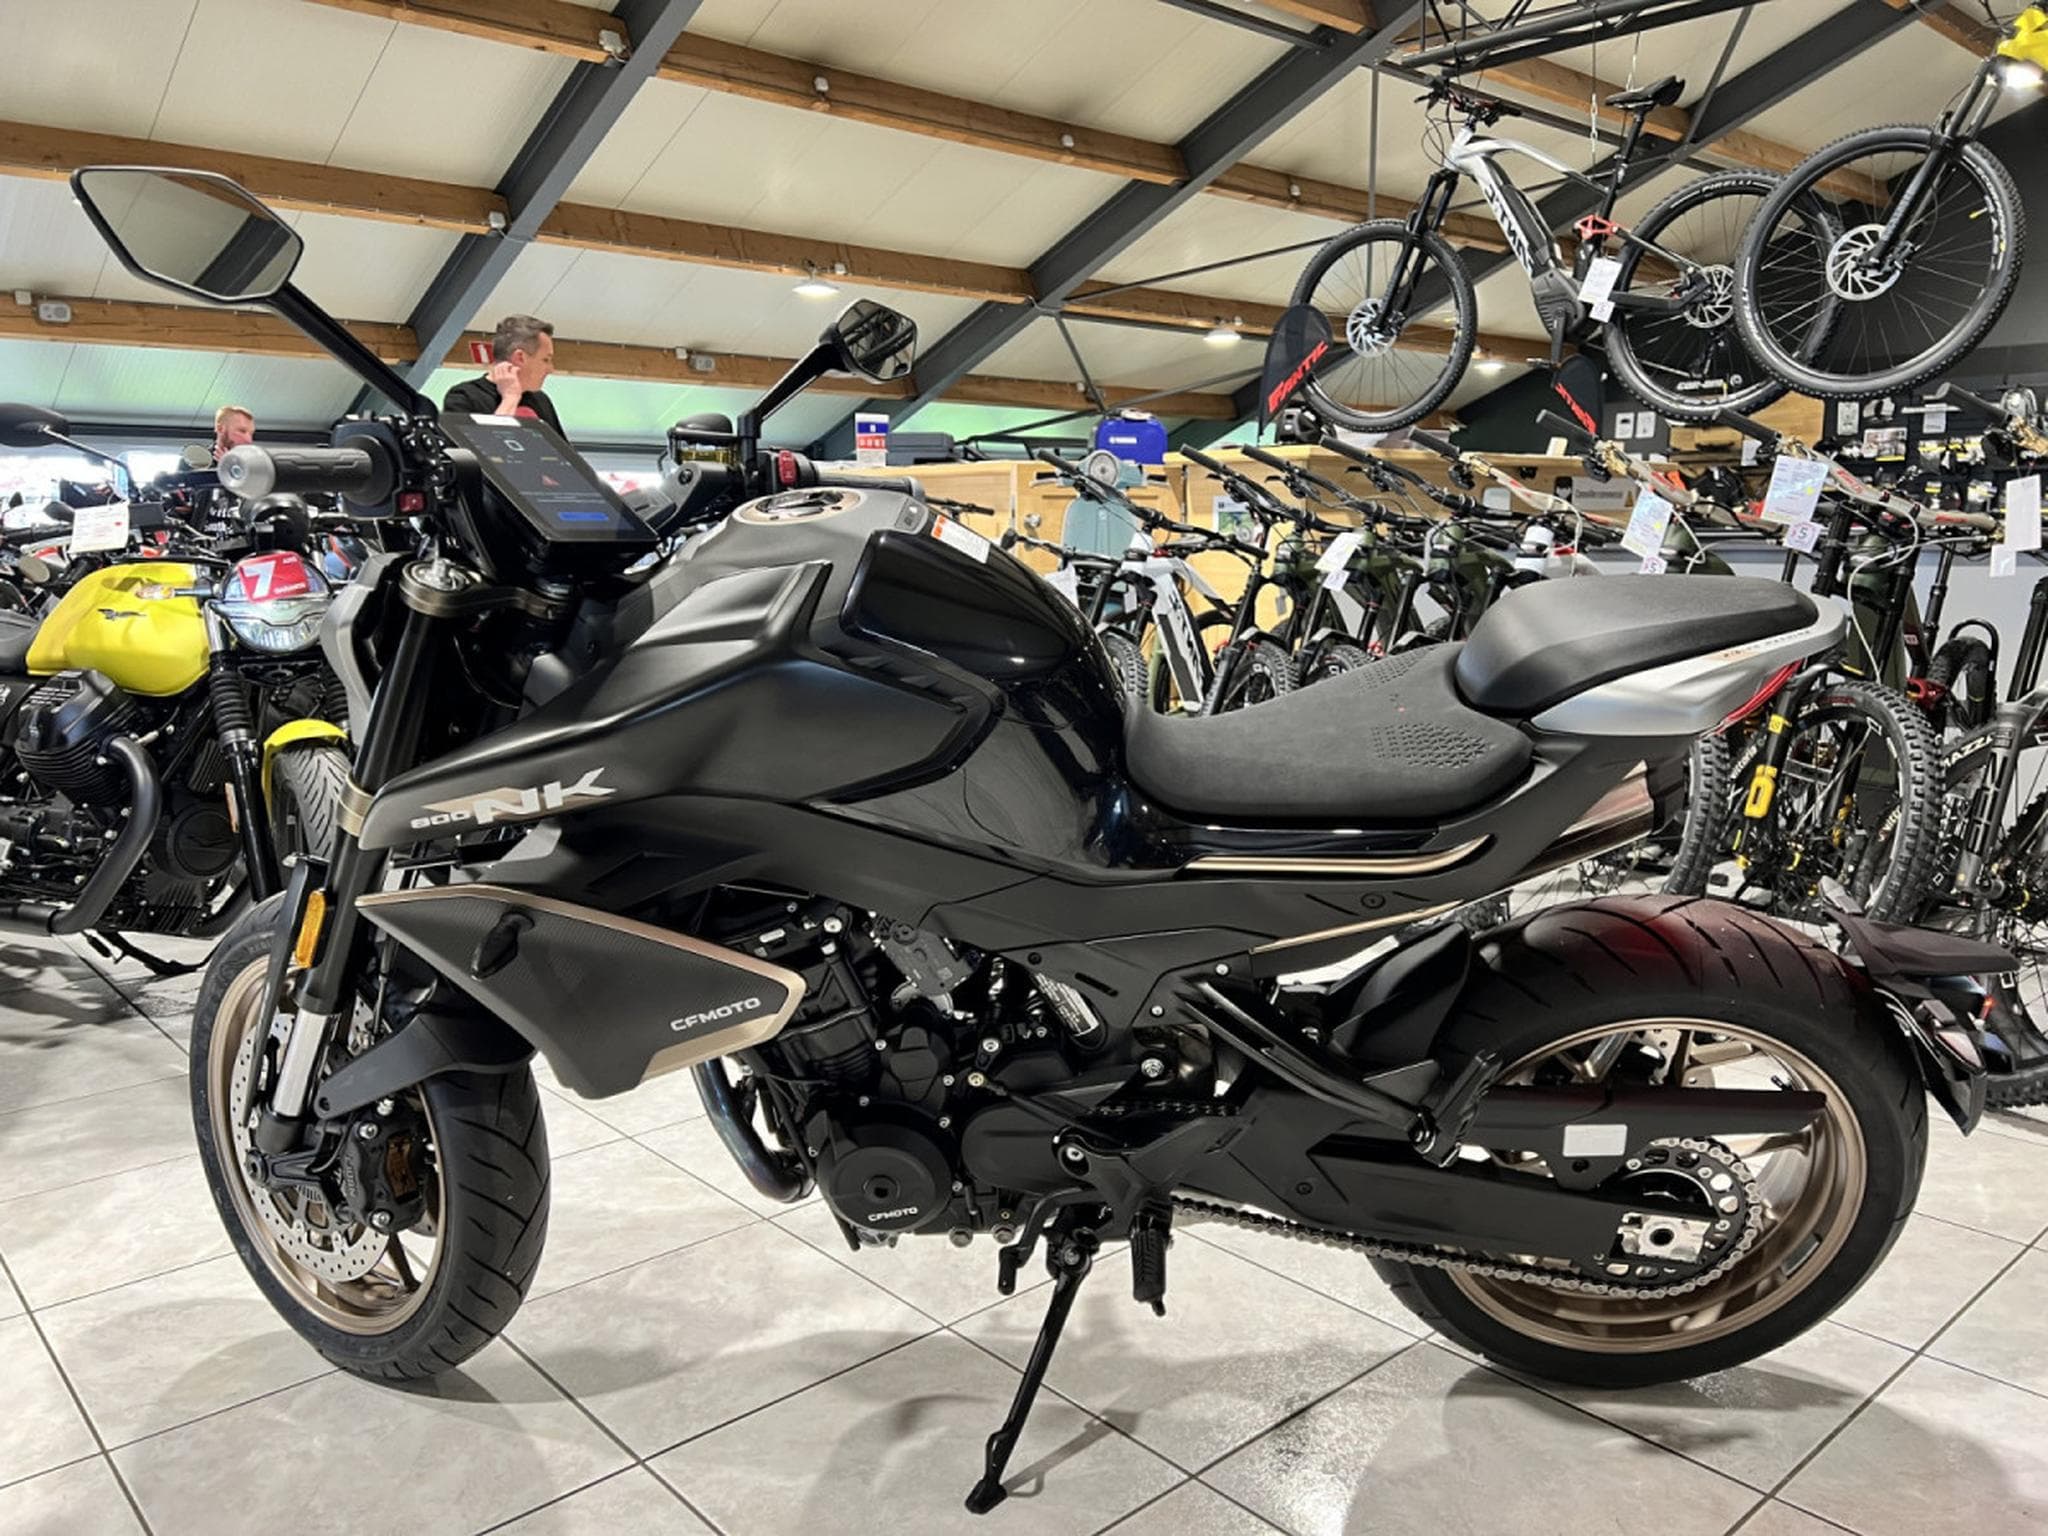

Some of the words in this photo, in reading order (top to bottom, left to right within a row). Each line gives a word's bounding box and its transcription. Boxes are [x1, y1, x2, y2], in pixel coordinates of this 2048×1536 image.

[1267, 340, 1328, 413] FANTIC
[242, 560, 276, 599] 7
[473, 767, 617, 825] NK
[670, 997, 761, 1031] CFMOTO
[867, 1206, 918, 1222] CFMOTO
